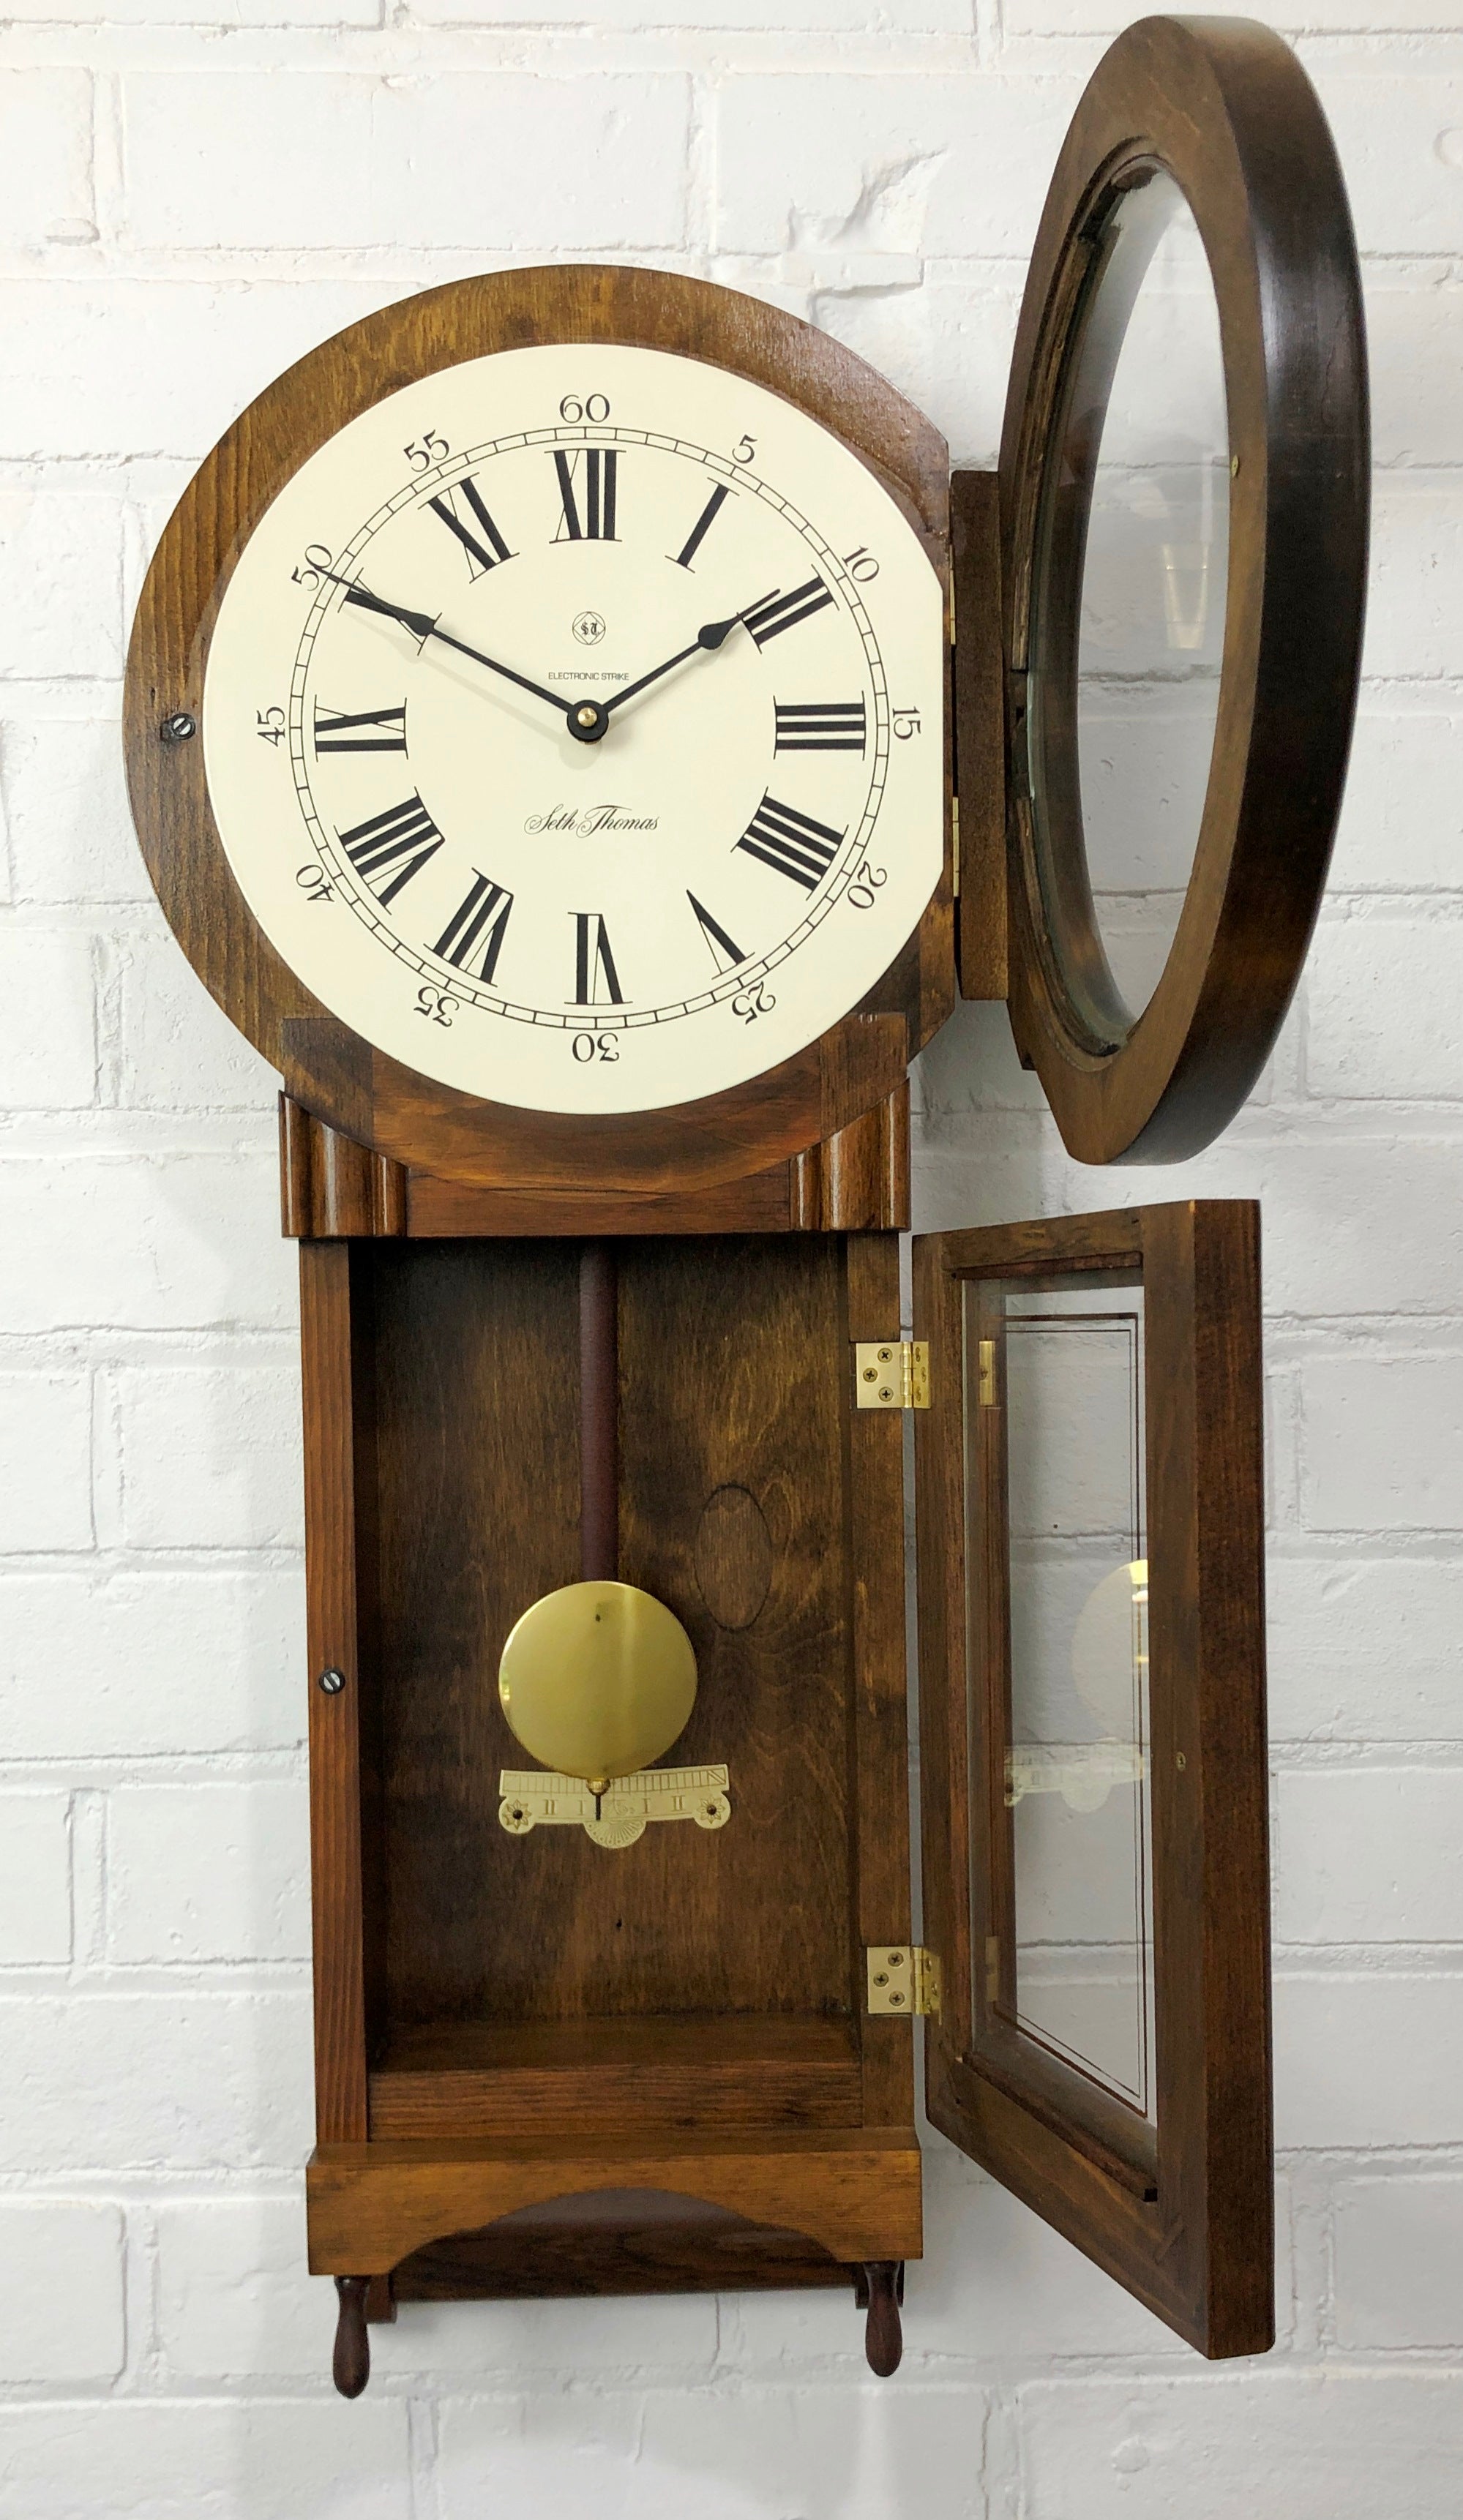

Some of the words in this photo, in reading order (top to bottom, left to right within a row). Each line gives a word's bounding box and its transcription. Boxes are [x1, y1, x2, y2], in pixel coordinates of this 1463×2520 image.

[559, 394, 610, 424] 60
[403, 429, 451, 473] 55
[732, 434, 758, 465] 5
[545, 449, 626, 544] XII
[418, 472, 520, 584] XI
[665, 477, 740, 574] I
[291, 544, 333, 592] 50
[842, 545, 880, 582] 10
[737, 563, 840, 654] II
[547, 672, 600, 680] ELECTRONIC
[601, 672, 629, 680] STRIKE
[257, 706, 286, 747] 45
[314, 694, 409, 762] IX
[773, 691, 867, 760] III
[892, 705, 921, 740] 15
[524, 803, 578, 836] Seth
[575, 805, 660, 839] Thomas
[730, 786, 849, 901] IIII
[333, 786, 446, 915] VIII
[295, 864, 335, 903] 40
[847, 860, 888, 910] 20
[423, 867, 515, 988] VII
[685, 889, 756, 980] V
[564, 912, 634, 1006] VI
[414, 986, 460, 1027] 35
[732, 980, 777, 1025] 25
[572, 1033, 621, 1062] 30
